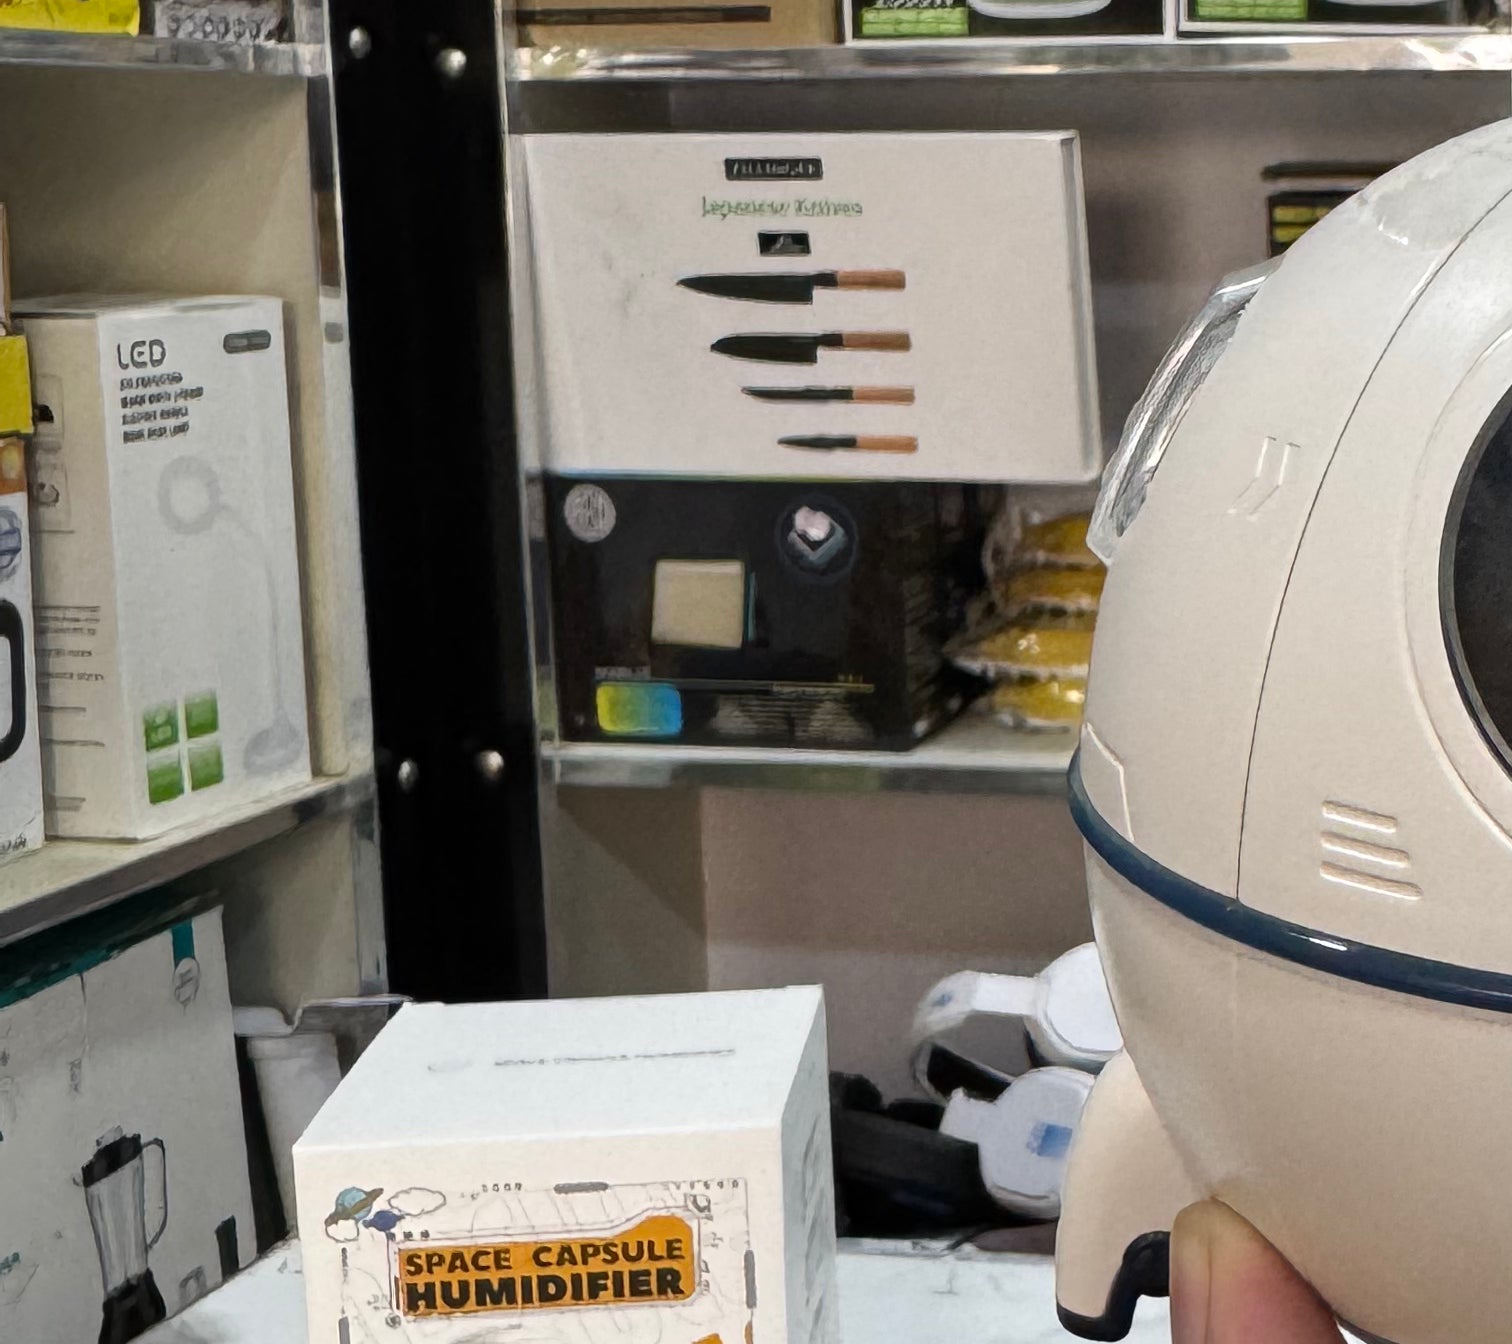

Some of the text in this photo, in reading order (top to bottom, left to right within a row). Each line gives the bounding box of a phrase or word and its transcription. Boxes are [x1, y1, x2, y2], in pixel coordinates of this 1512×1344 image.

[117, 339, 166, 370] LED
[405, 1238, 686, 1277] SPACE CAPSULE
[404, 1266, 685, 1313] HUMIDIFIER
